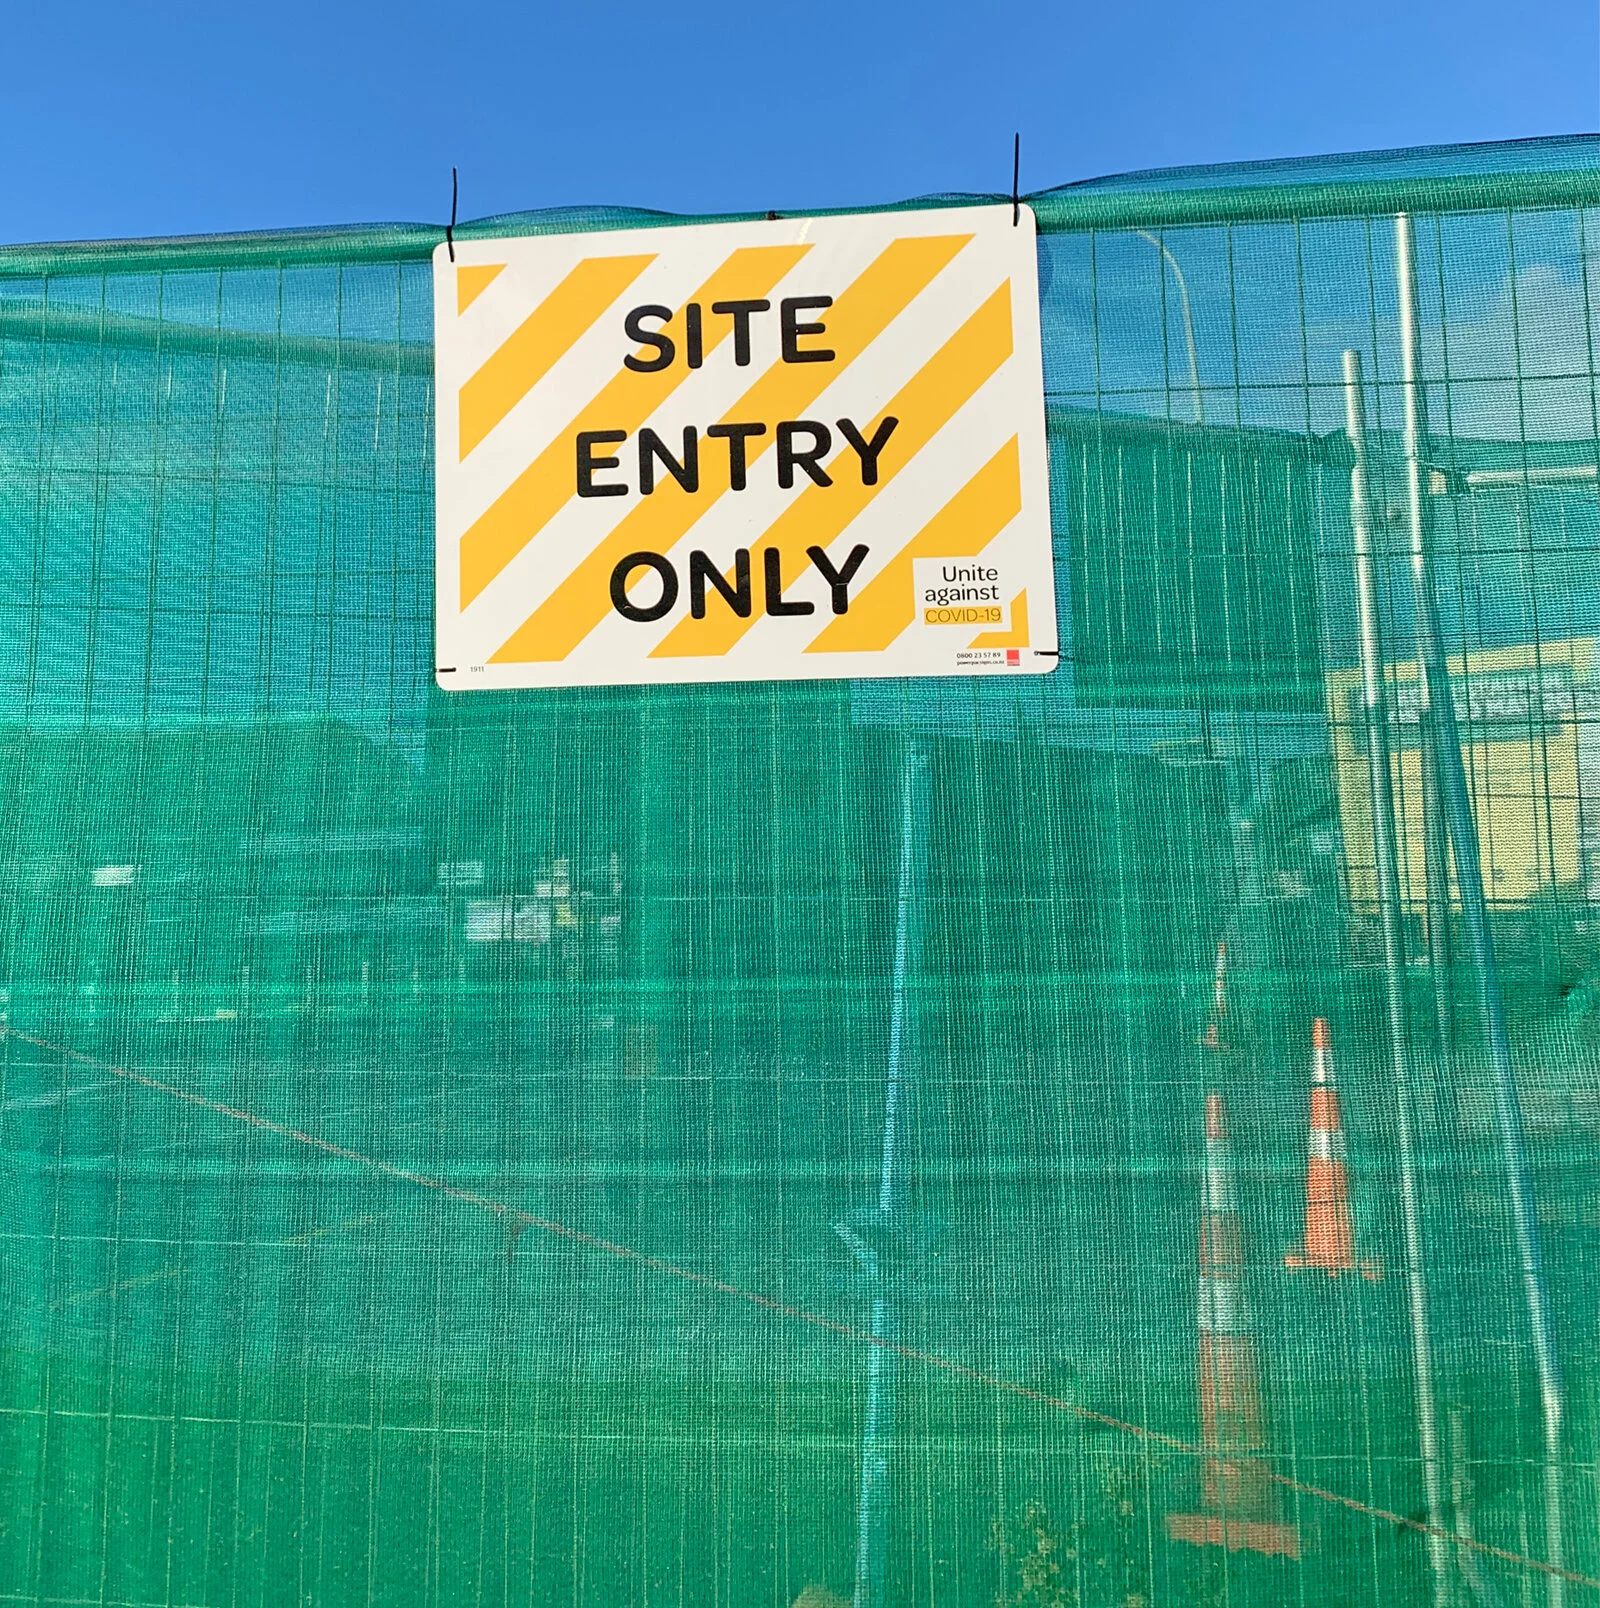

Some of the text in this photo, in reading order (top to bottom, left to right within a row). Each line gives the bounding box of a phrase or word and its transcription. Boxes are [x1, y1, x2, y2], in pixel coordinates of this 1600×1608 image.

[624, 296, 835, 373] SITE
[577, 417, 898, 498] ENTRY
[610, 544, 869, 622] ONLY
[925, 583, 999, 606] against
[942, 564, 998, 582] Unite
[925, 608, 1001, 623] COVID-19
